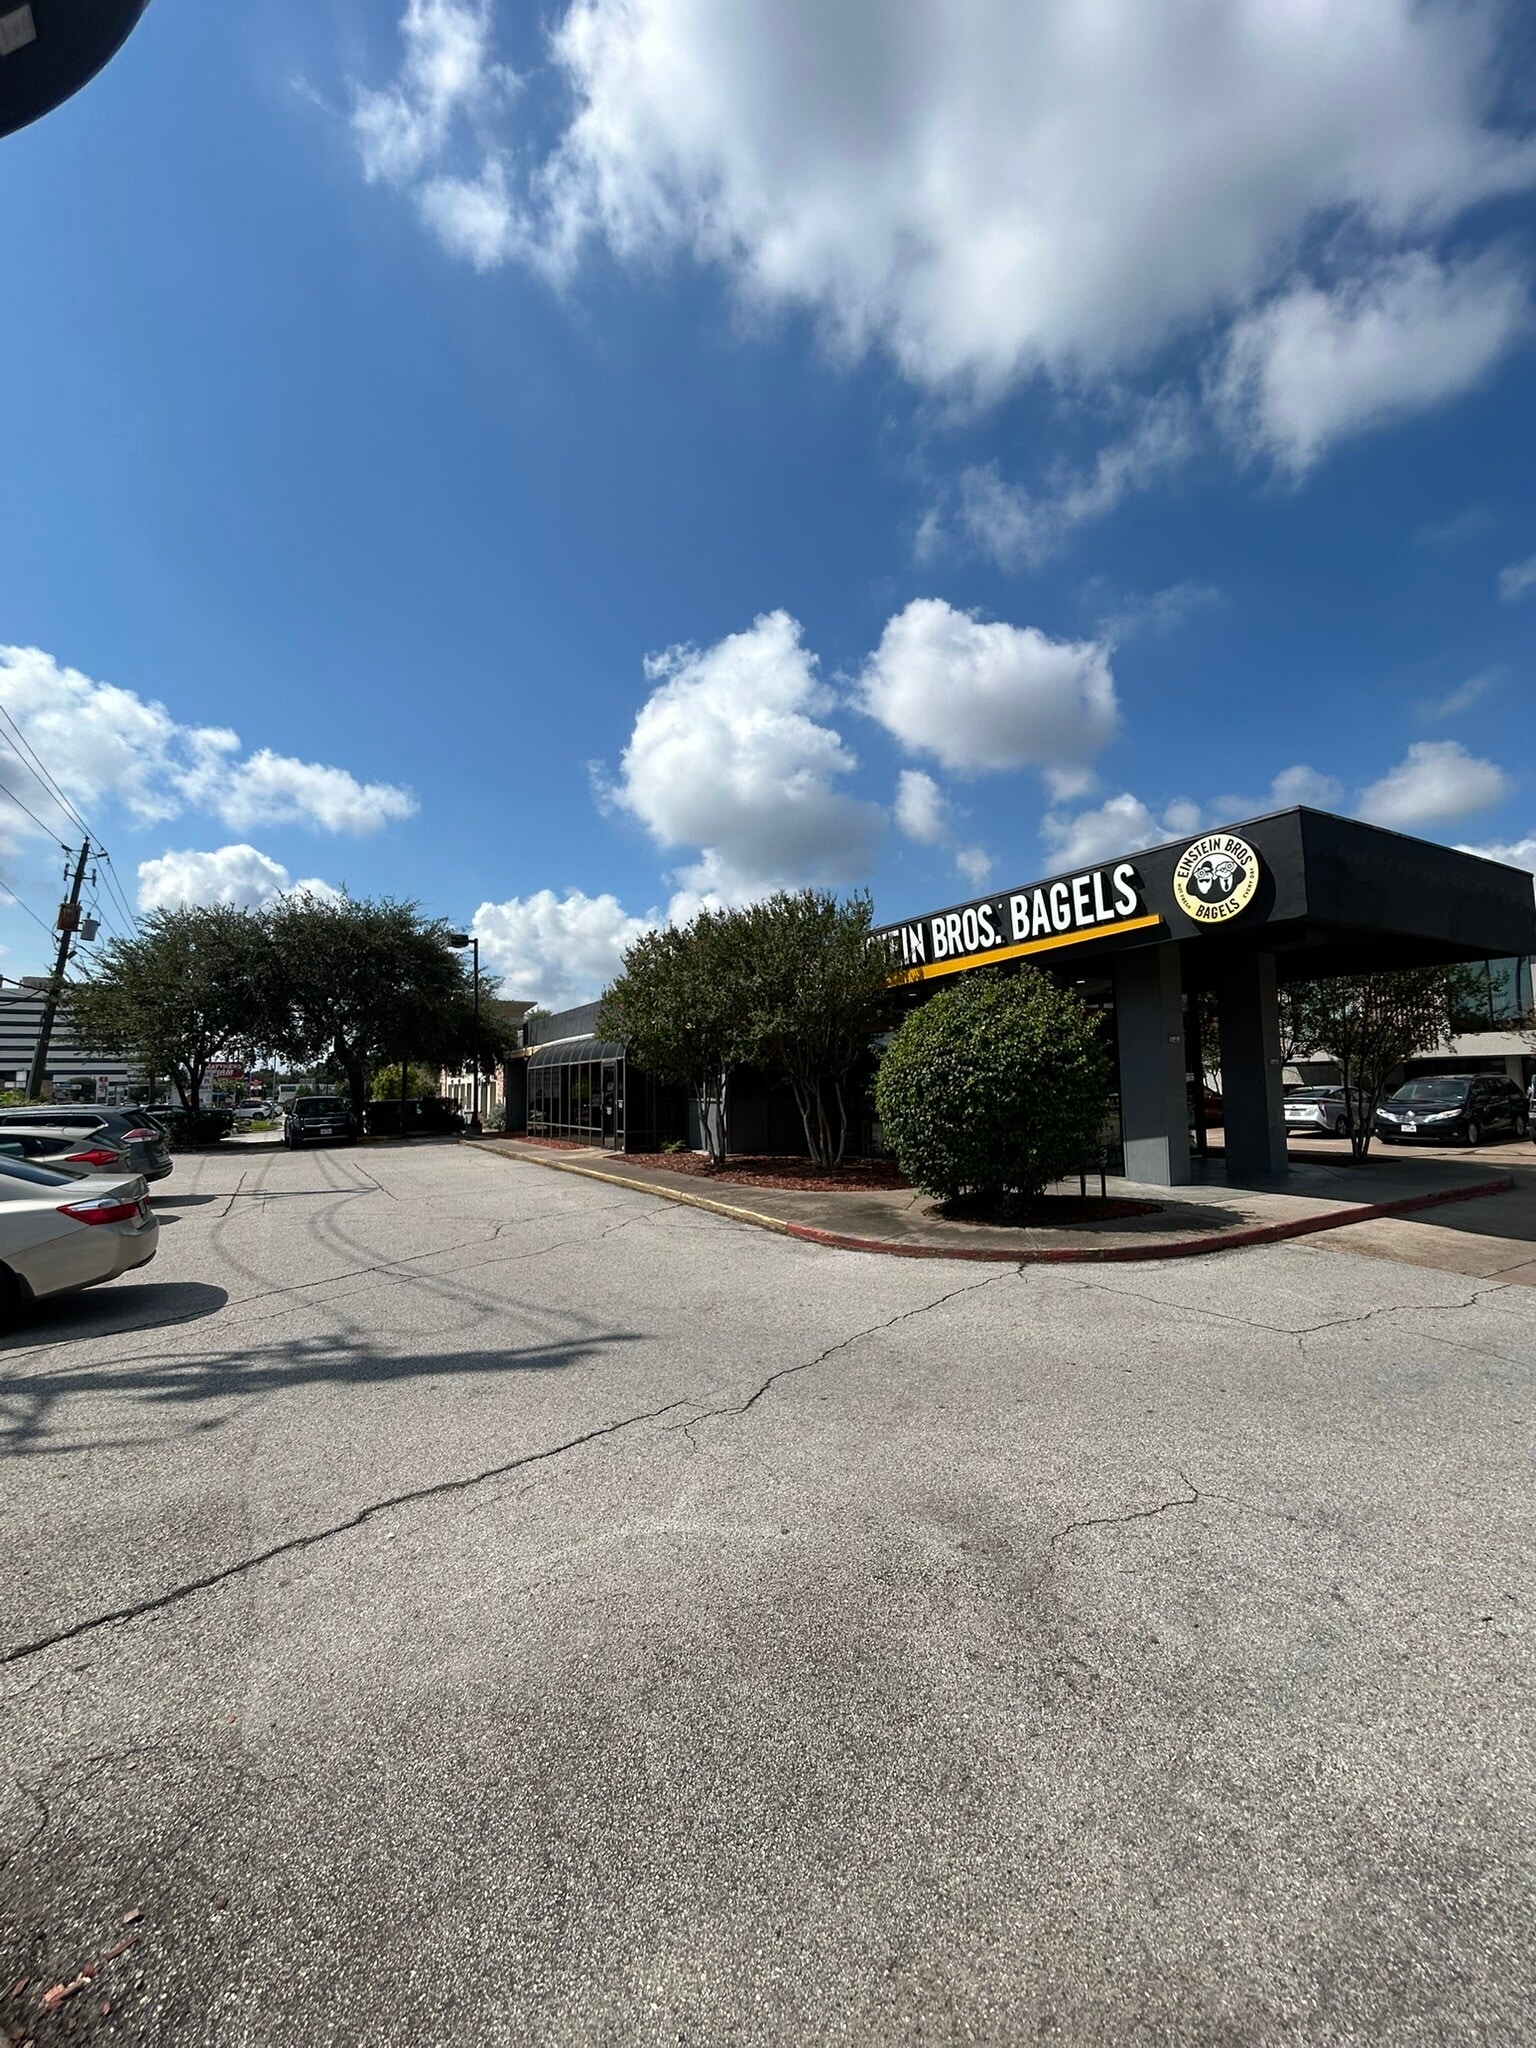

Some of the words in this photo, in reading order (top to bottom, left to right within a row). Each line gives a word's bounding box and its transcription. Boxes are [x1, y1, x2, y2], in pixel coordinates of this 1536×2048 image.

[1177, 838, 1221, 878] EINSTEIN
[1224, 838, 1253, 866] BROS
[1010, 863, 1138, 940] BAGELS
[1196, 898, 1240, 919] BAGELS
